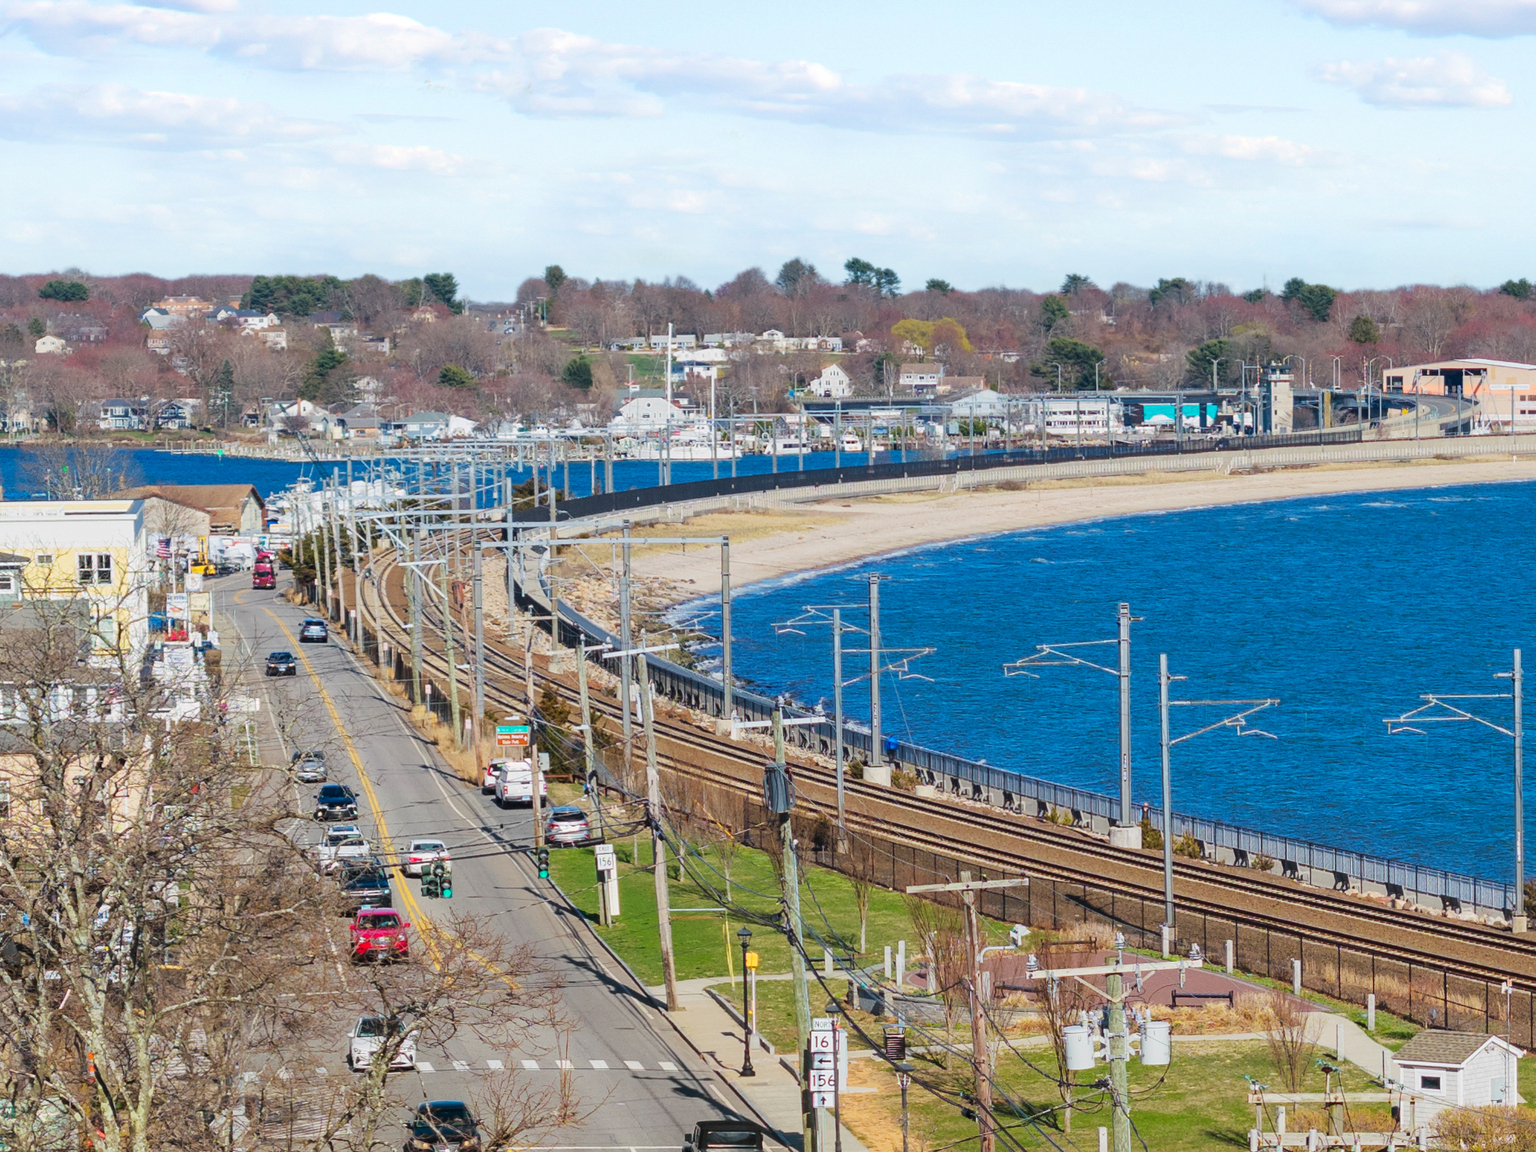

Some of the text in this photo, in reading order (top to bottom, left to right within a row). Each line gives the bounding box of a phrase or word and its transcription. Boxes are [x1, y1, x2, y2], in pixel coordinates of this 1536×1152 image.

[599, 857, 611, 867] 156
[815, 1036, 830, 1048] 16
[812, 1075, 835, 1087] 156
